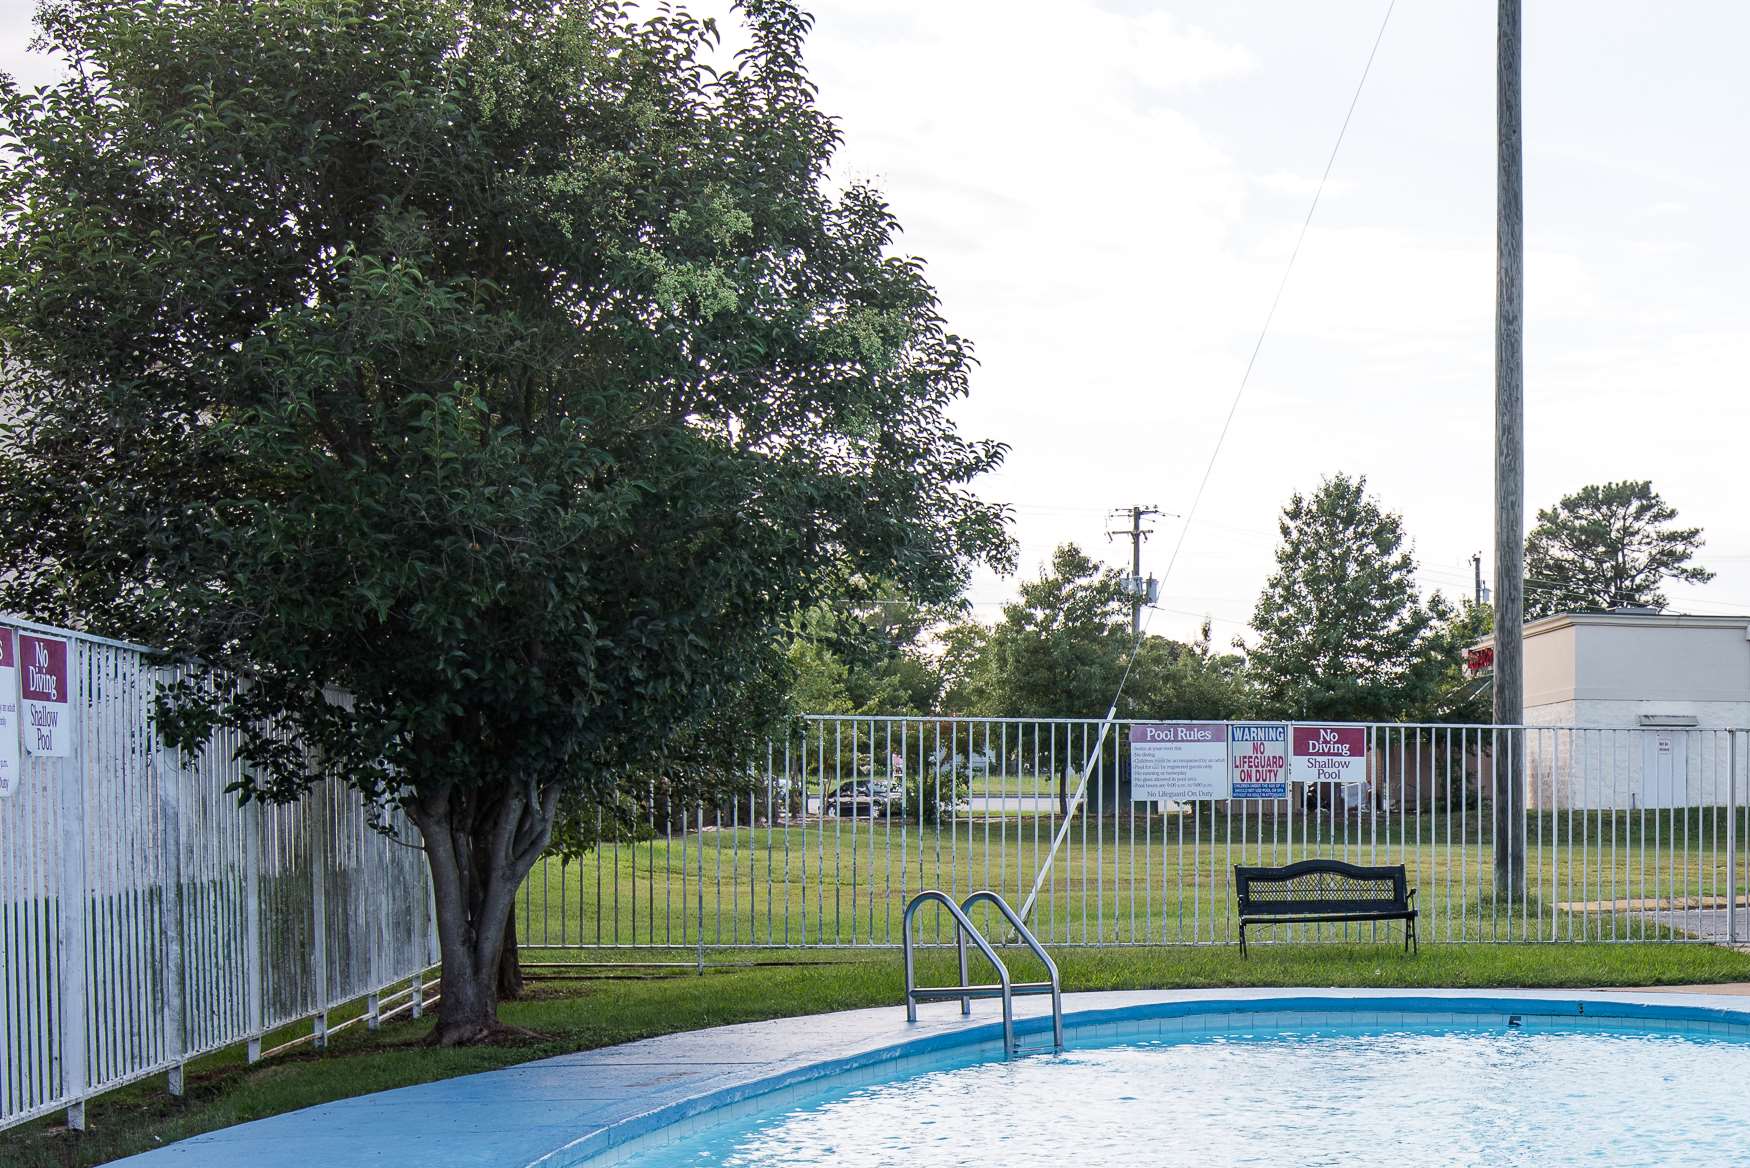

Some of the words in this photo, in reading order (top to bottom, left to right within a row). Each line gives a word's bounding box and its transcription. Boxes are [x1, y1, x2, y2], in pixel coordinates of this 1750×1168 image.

[34, 641, 49, 668] No
[29, 665, 57, 700] Diving
[30, 703, 59, 728] Shallow
[37, 727, 53, 751] Pool
[1146, 727, 1174, 741] Pool
[1177, 727, 1212, 740] Rules
[1233, 727, 1285, 741] WARNING
[1320, 729, 1338, 741] No
[1252, 742, 1265, 755] NO
[1309, 740, 1350, 757] Diving
[1234, 755, 1284, 769] LIFEGUARD
[1307, 758, 1350, 769] Shallow
[1240, 769, 1252, 782] ON
[1255, 769, 1278, 782] DUTY
[1318, 769, 1341, 780] Pool
